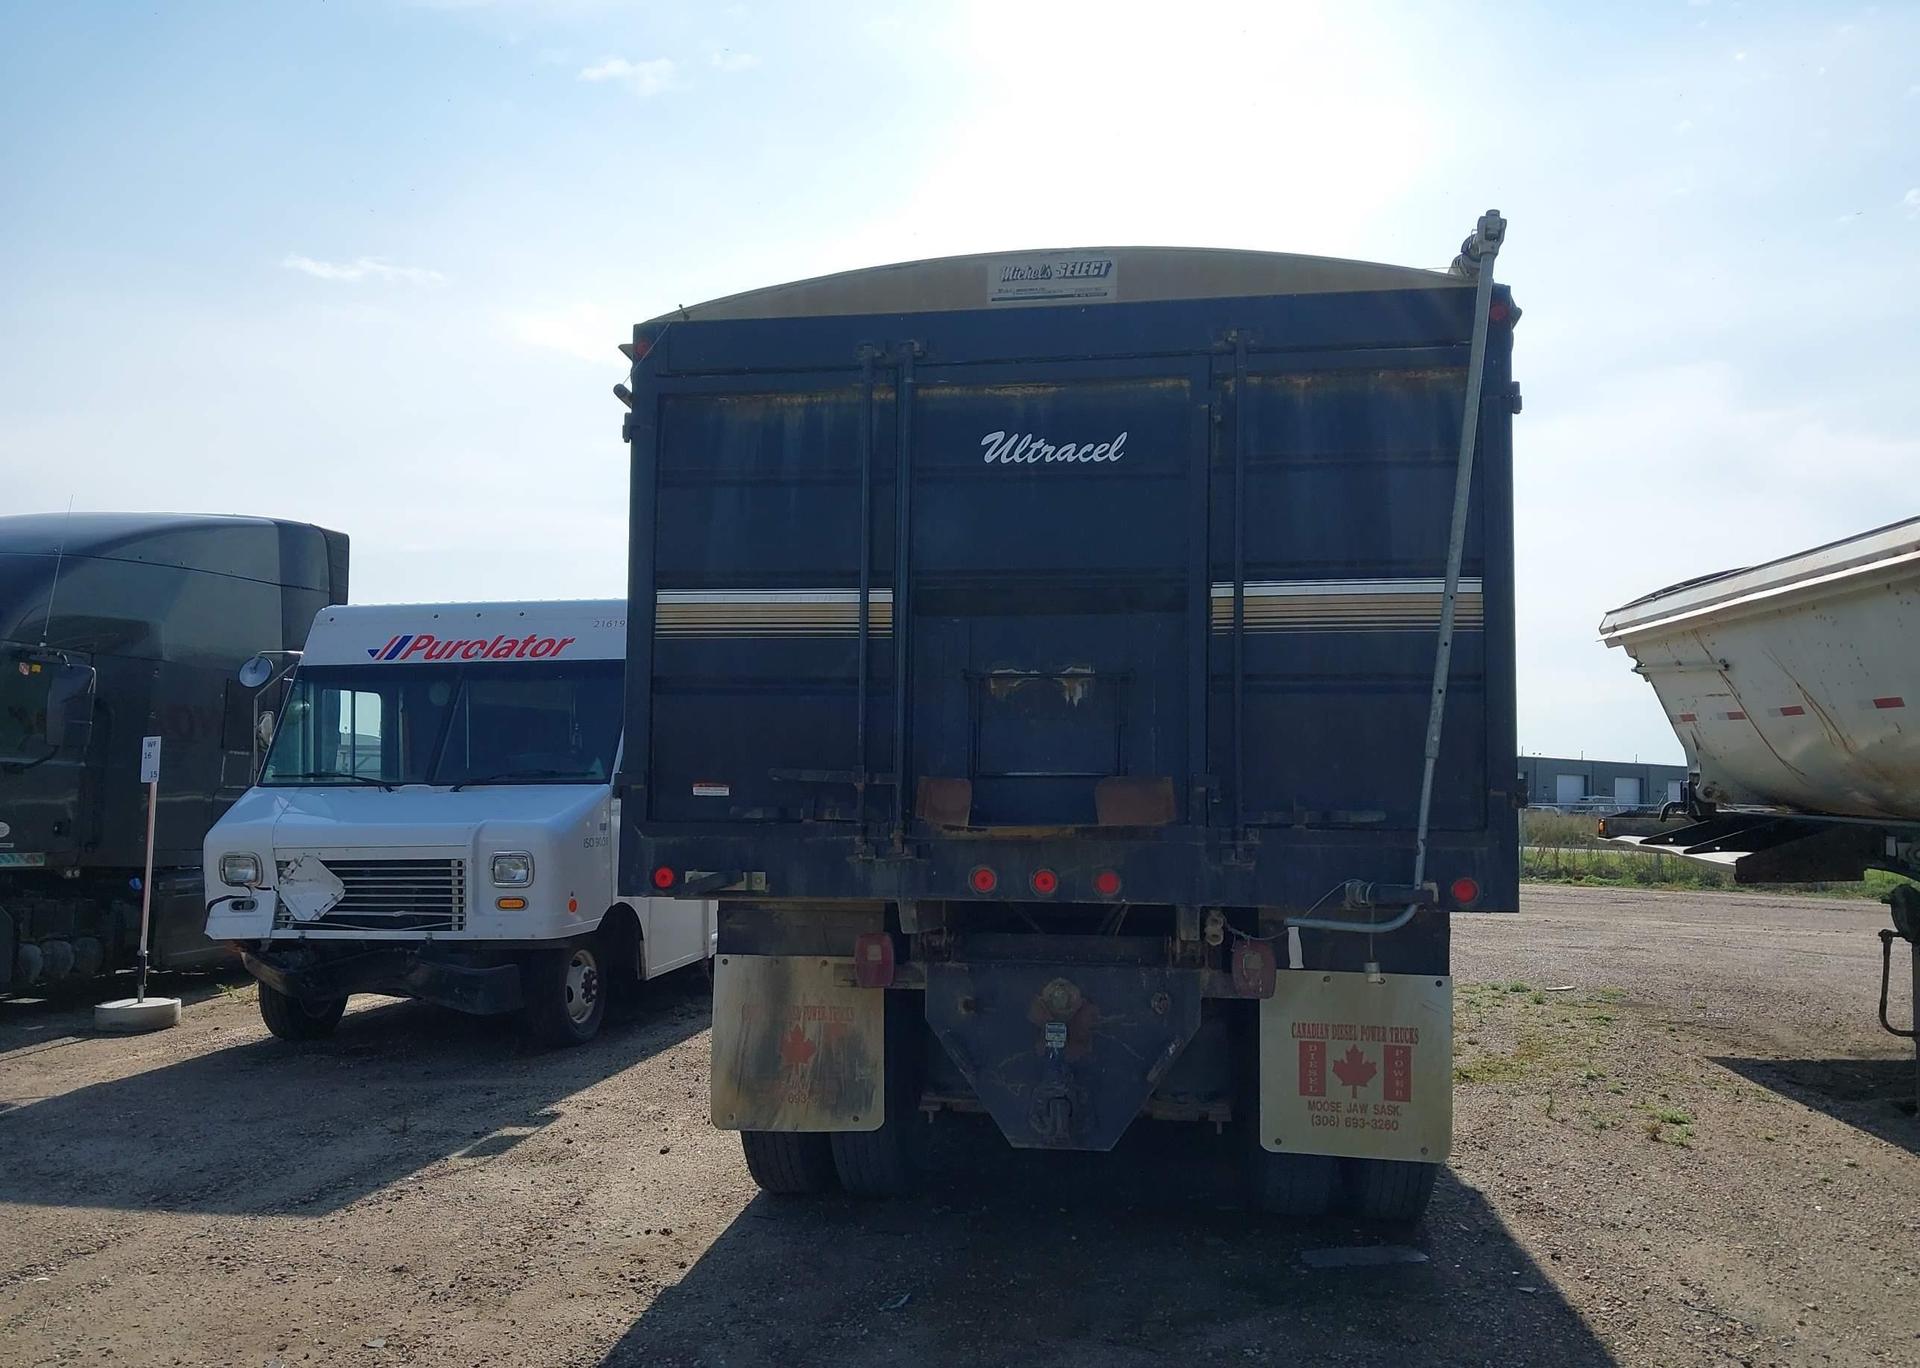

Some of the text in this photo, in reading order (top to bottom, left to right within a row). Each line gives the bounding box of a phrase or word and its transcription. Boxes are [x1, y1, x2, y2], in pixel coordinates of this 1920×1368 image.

[1000, 260, 1112, 282] Michel's SELECT
[981, 430, 1128, 464] Ultracel
[400, 634, 576, 660] Purolator
[144, 751, 152, 760] 16
[150, 770, 158, 778] 15
[1291, 1022, 1420, 1045] CANADIAN DIESEL POWER TRUCKS
[1308, 1044, 1318, 1093] DIESEL
[1307, 1099, 1342, 1113] MOOSE
[1346, 1101, 1369, 1115] JAW
